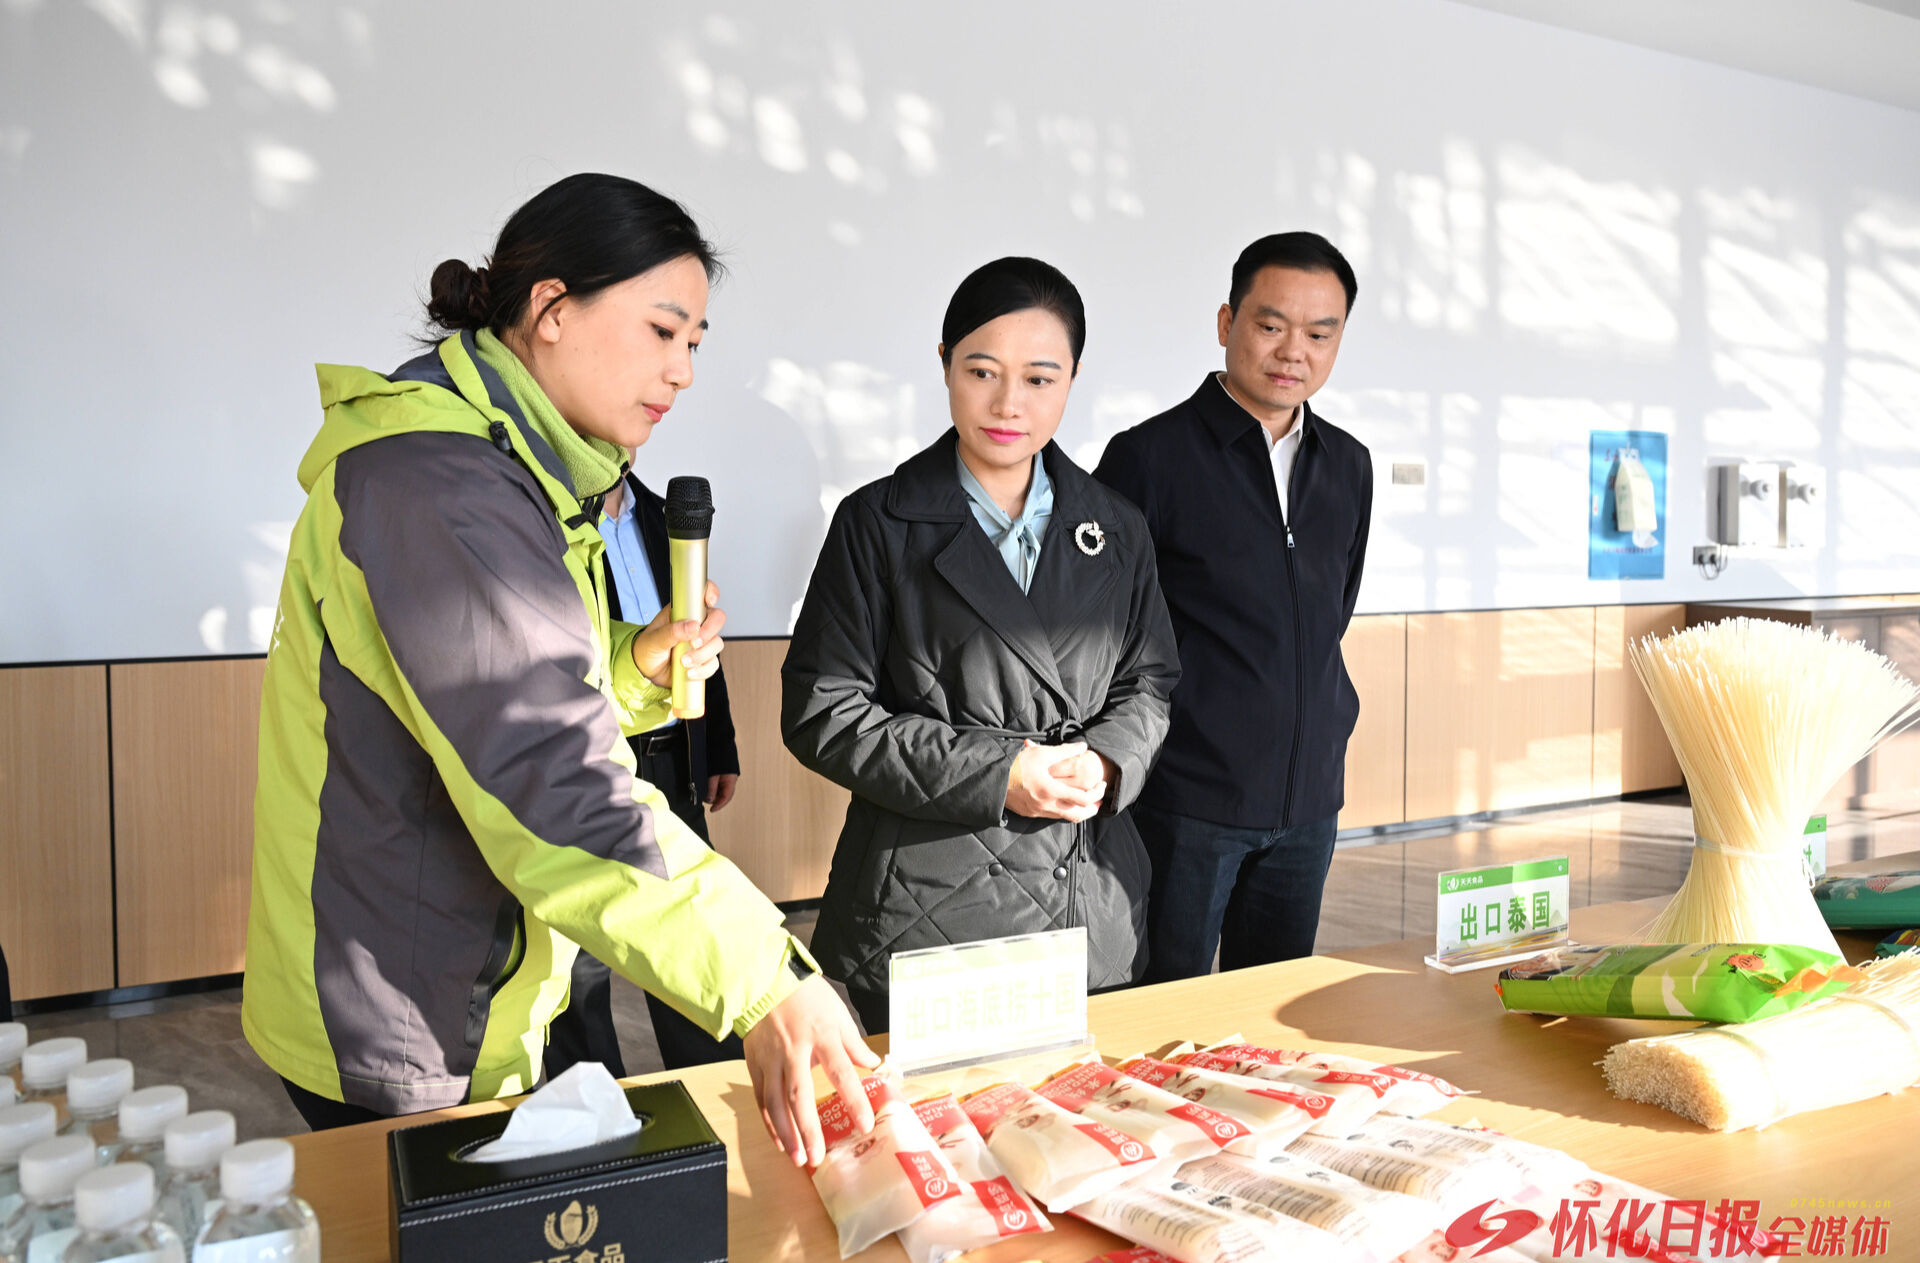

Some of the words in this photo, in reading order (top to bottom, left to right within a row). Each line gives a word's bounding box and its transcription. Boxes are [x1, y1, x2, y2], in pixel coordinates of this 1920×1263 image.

[1460, 875, 1484, 886] 天天食品
[1460, 890, 1550, 941] 出口泰国
[905, 971, 1075, 1040] 出口海底捞十国
